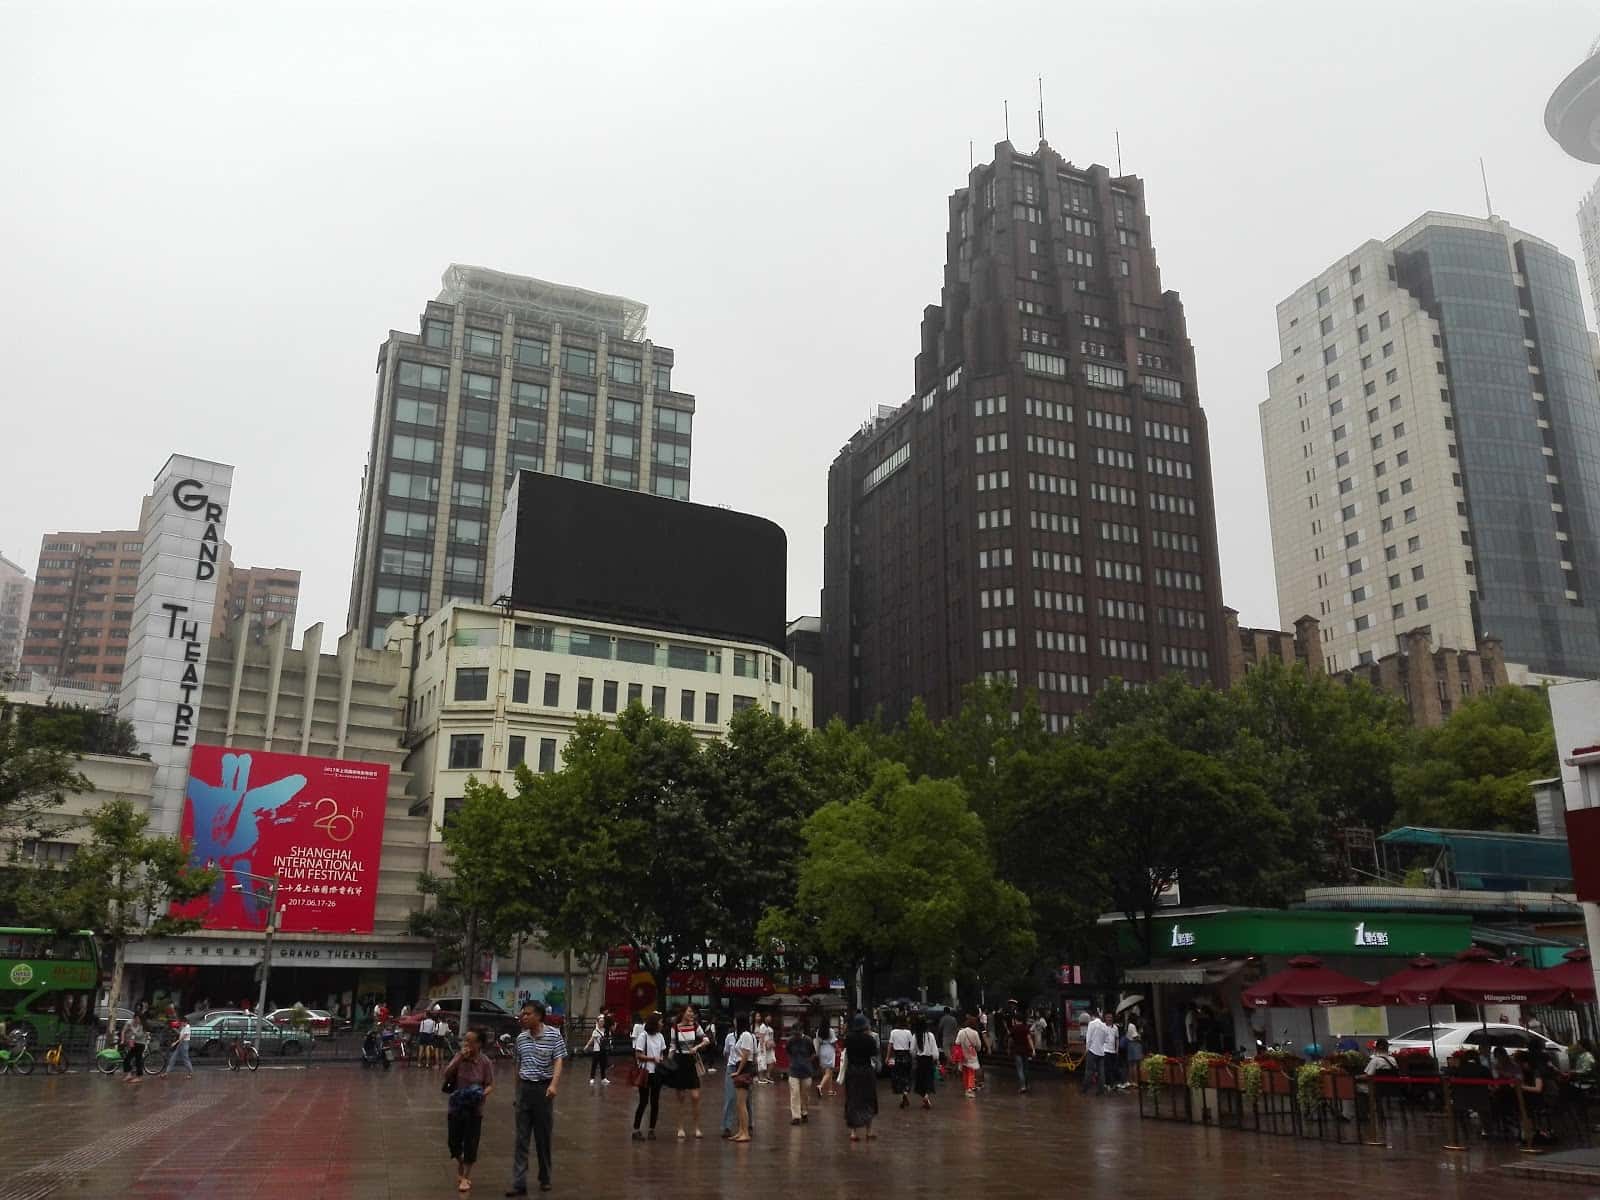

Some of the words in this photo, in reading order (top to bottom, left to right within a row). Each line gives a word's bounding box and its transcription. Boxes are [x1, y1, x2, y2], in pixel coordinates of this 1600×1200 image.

[172, 479, 223, 581] GRAND
[162, 603, 201, 746] THEATRE
[290, 846, 352, 859] SHANGHAI
[273, 855, 365, 872] INTERNATIONAL
[277, 866, 305, 879] FILM
[307, 869, 359, 882] FESTIVAL
[280, 948, 320, 959] GRAND
[327, 949, 378, 960] THEATRE
